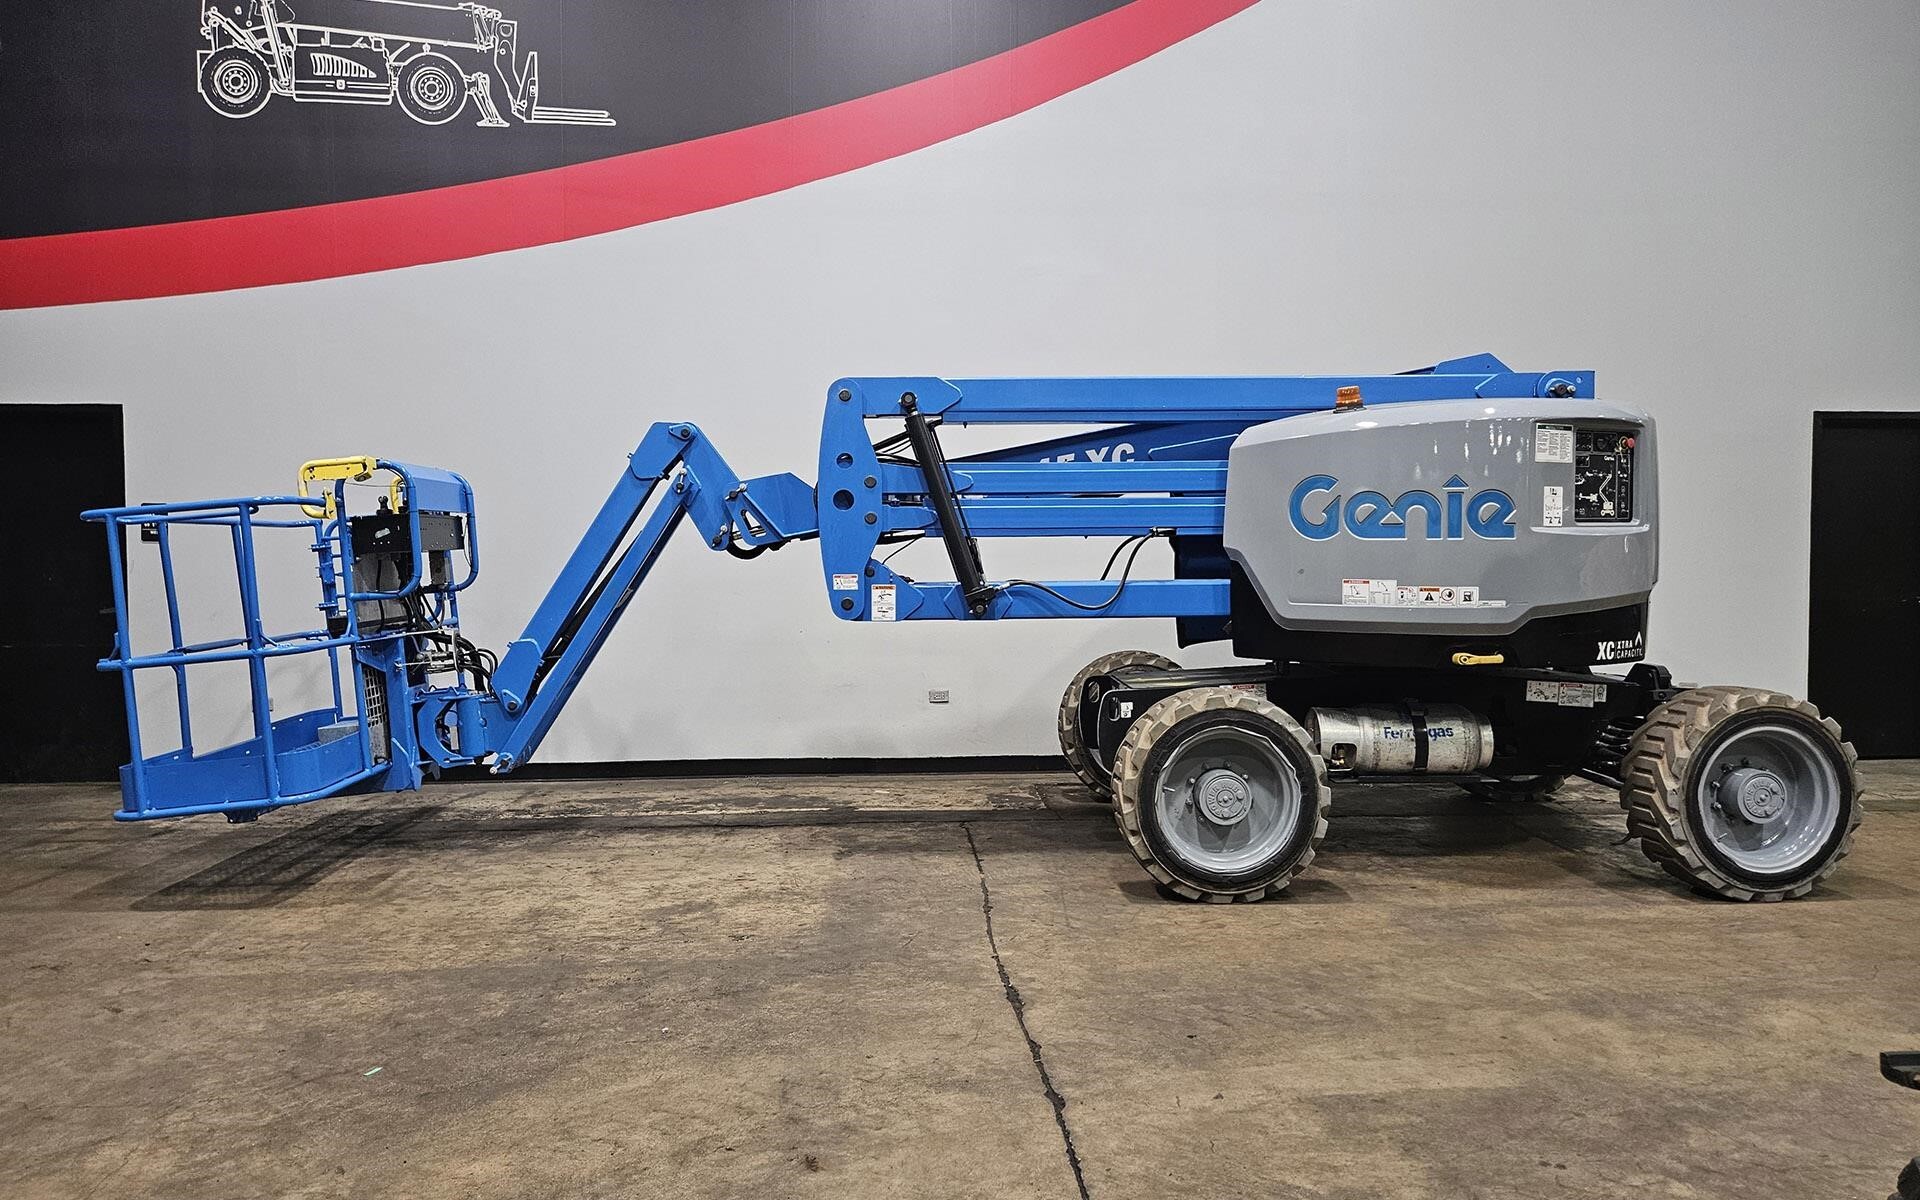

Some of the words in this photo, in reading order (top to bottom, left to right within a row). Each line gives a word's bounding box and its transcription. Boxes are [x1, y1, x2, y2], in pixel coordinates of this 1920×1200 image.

[1289, 474, 1516, 541] Genie
[1596, 641, 1615, 660] XC
[1616, 640, 1633, 649] XTRA
[1384, 727, 1454, 741] Ferrgas
